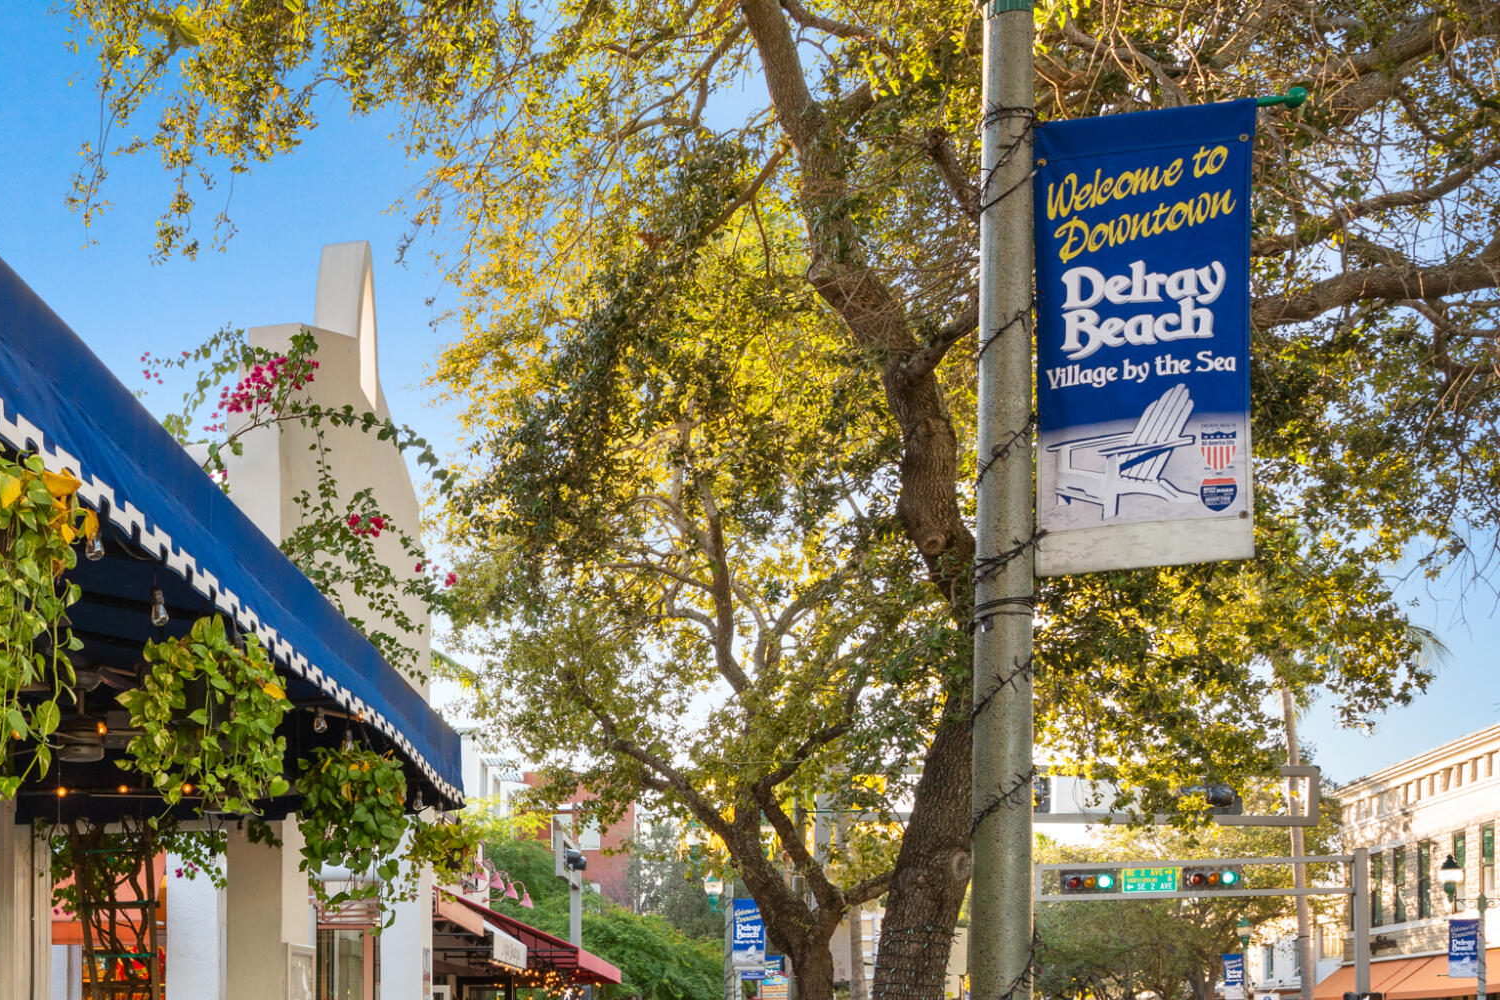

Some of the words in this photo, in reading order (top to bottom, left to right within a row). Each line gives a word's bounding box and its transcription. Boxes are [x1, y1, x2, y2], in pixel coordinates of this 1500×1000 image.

[1046, 158, 1183, 220] Welcome
[1192, 145, 1229, 179] to
[1054, 188, 1236, 264] Downtown
[1060, 259, 1227, 310] Delray
[1059, 295, 1214, 361] Beach
[1045, 364, 1118, 390] Village
[1123, 358, 1149, 382] by
[1154, 353, 1191, 376] the
[1195, 350, 1237, 372] Sea
[1160, 881, 1173, 890] AVE
[1451, 938, 1476, 948] Delray
